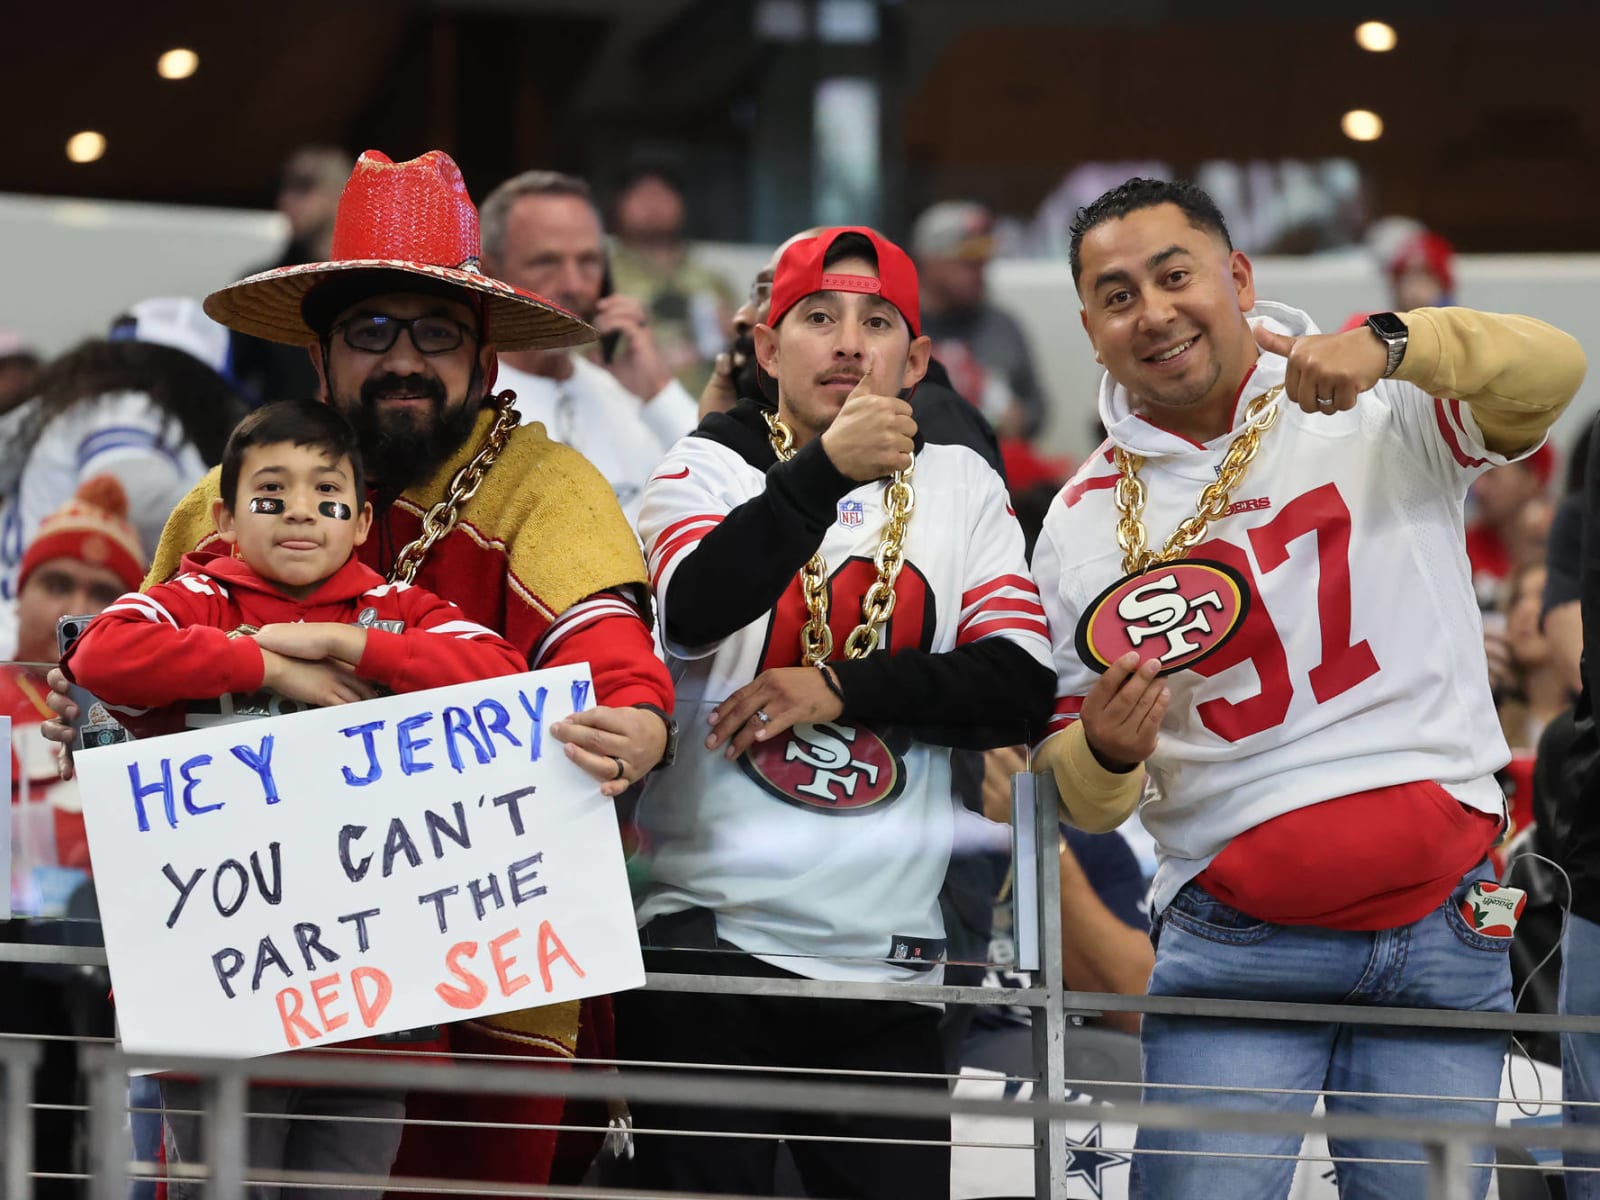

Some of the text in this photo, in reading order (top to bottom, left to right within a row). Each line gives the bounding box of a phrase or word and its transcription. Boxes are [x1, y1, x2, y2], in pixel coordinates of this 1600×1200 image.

[841, 511, 861, 525] NFL
[1118, 574, 1223, 663] SF
[1183, 481, 1381, 743] 97
[128, 680, 590, 832] HEY JERRY!
[786, 721, 879, 801] SF
[162, 786, 536, 928] YOU CAN'T
[212, 852, 547, 999] PART THE
[275, 920, 585, 1047] RED SEA
